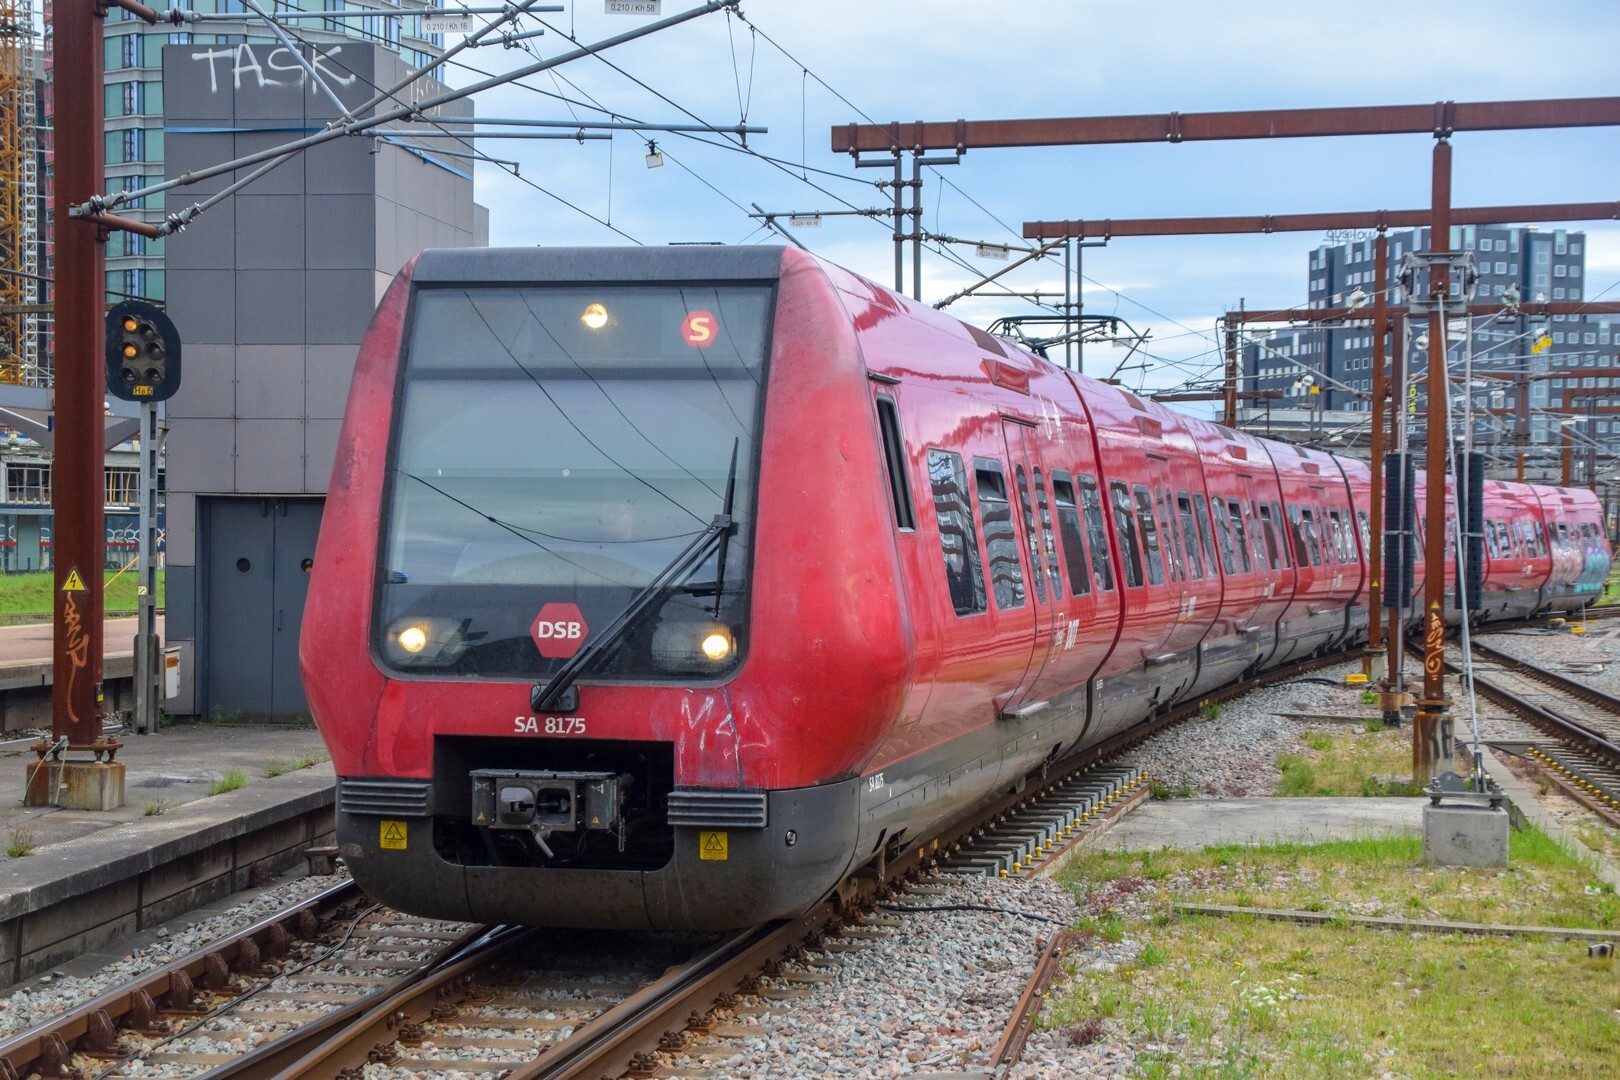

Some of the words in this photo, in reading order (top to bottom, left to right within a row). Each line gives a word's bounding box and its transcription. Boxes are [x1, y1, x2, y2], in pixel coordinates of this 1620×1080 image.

[610, 3, 630, 11] 0.210
[635, 4, 644, 12] Kh
[646, 4, 655, 12] 58
[426, 22, 444, 31] 0.210
[449, 22, 459, 30] Kh
[460, 22, 468, 30] 16
[192, 43, 356, 94] TASK
[689, 317, 711, 341] S
[538, 621, 581, 639] DSB
[514, 716, 539, 733] SA
[544, 717, 586, 734] 8175
